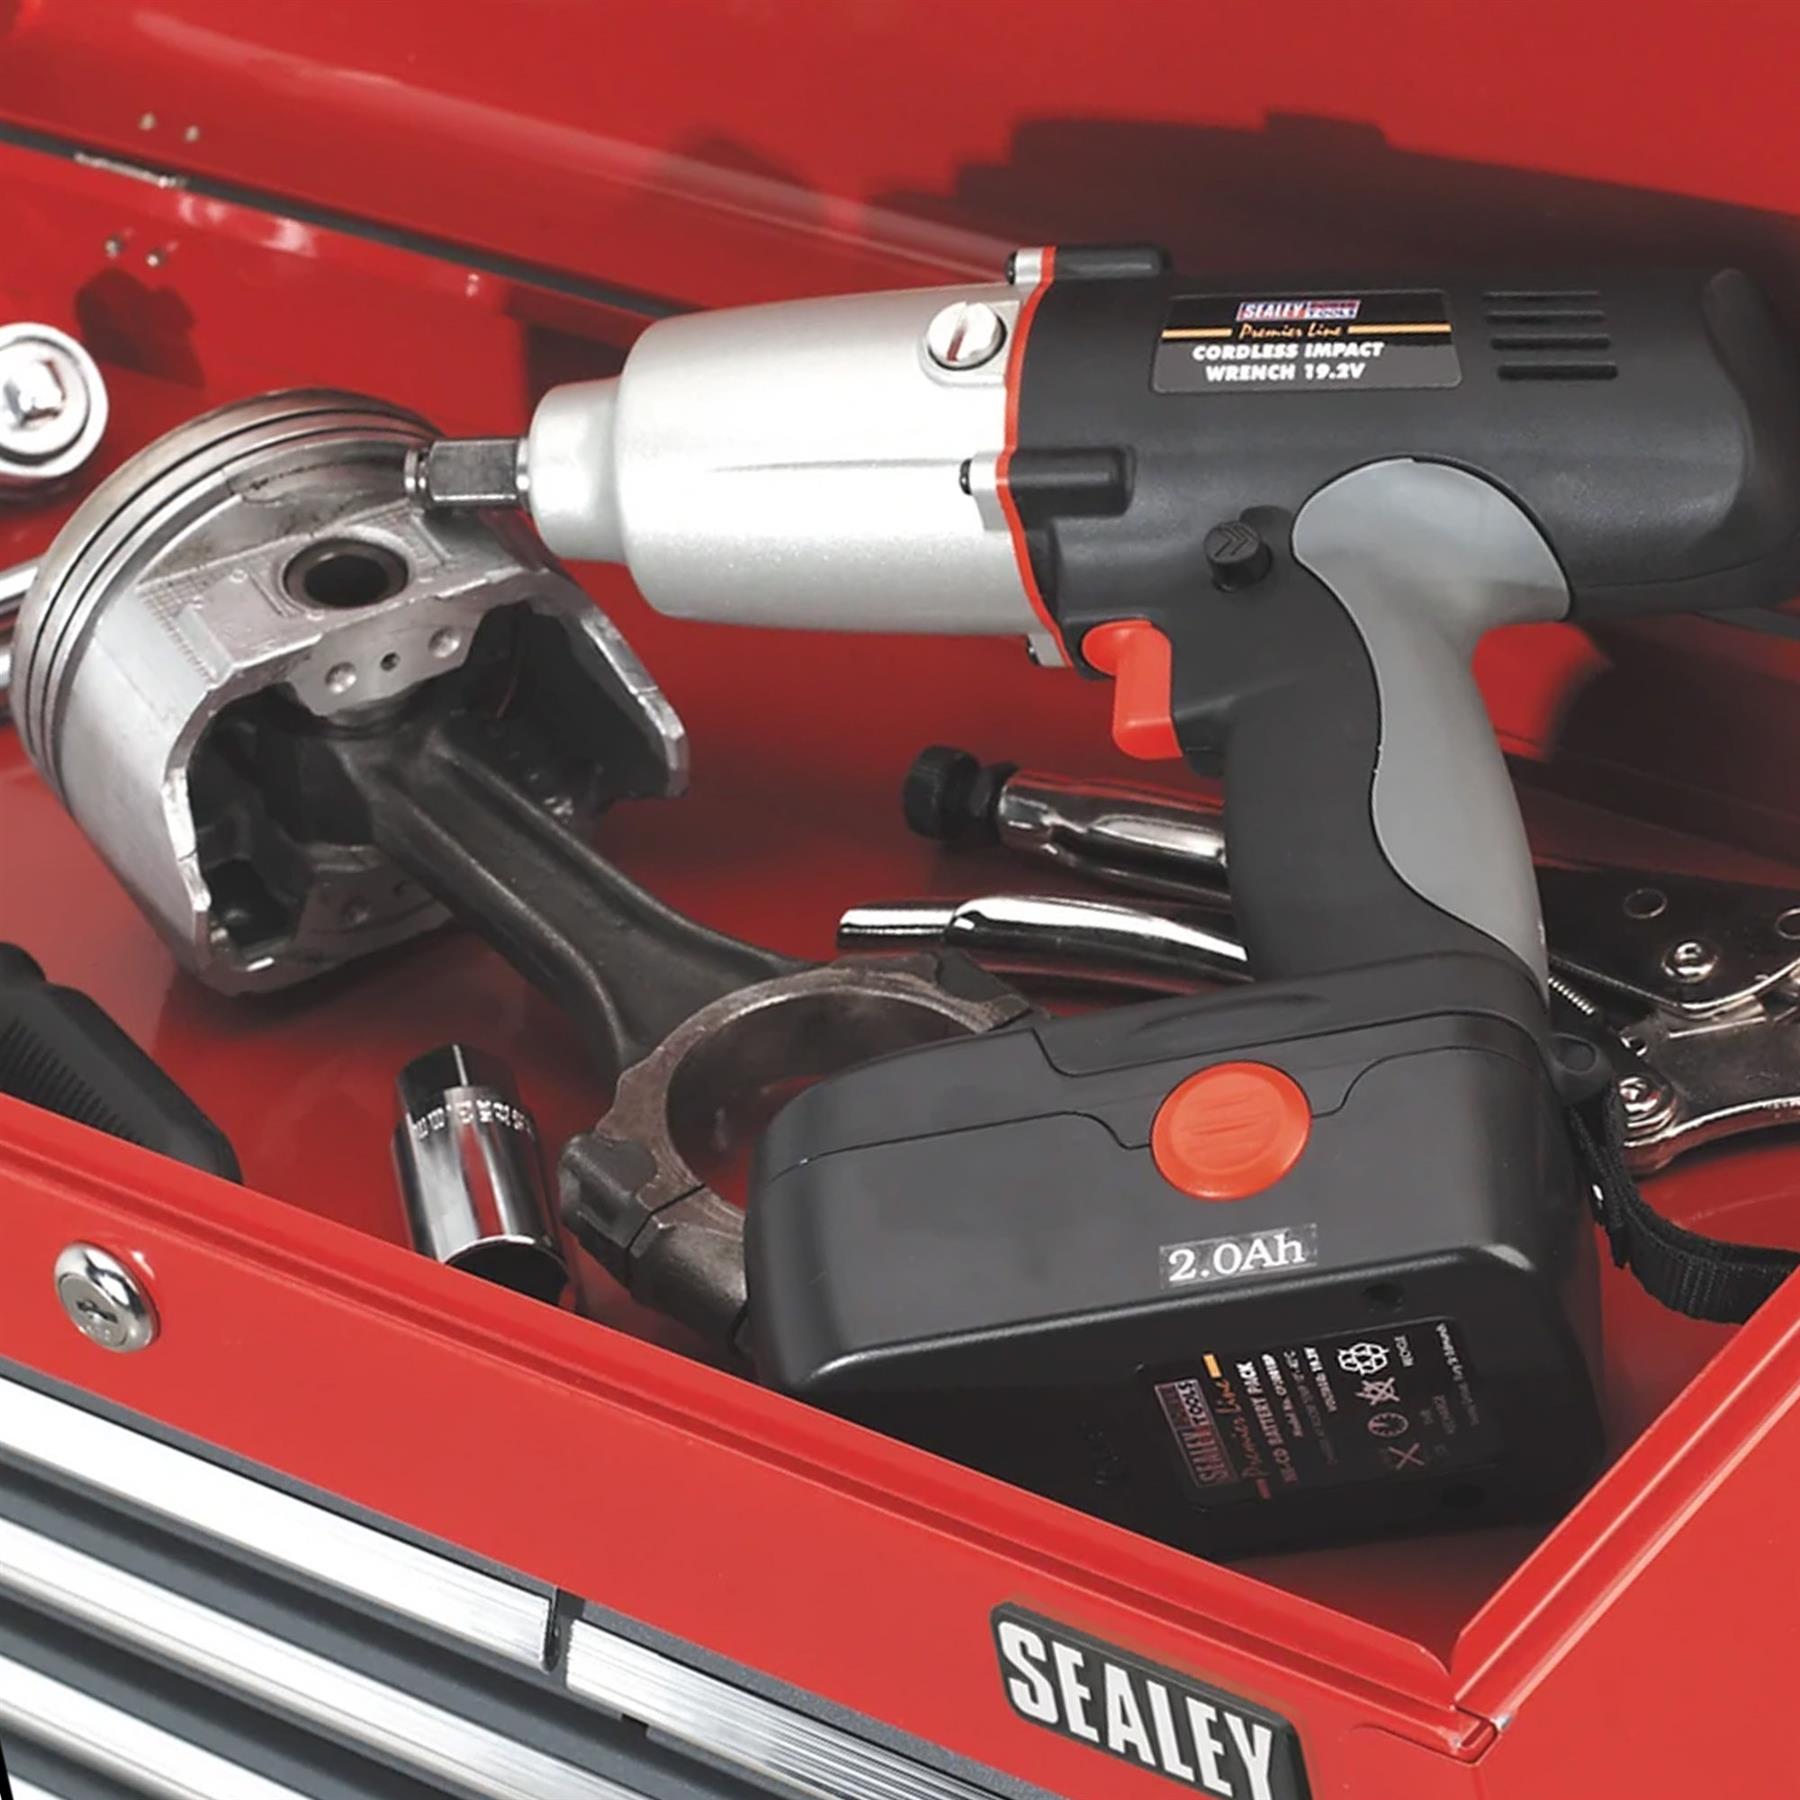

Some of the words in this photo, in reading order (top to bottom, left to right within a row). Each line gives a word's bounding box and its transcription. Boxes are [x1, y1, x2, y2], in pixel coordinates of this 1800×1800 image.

[1244, 302, 1303, 319] SEALEY
[1239, 322, 1302, 340] Premier
[1307, 322, 1342, 337] Line
[1192, 343, 1298, 360] CORDLESS
[1304, 342, 1384, 358] IMPACT
[1206, 364, 1295, 382] WRENCH
[1304, 363, 1366, 379] 19.2V
[1169, 1233, 1306, 1281] 2.0Ah
[1214, 1378, 1242, 1414] Line
[1236, 1361, 1261, 1395] PACK
[1177, 1382, 1207, 1424] TOOLS
[1251, 1397, 1283, 1445] BATTERY
[1180, 1427, 1231, 1482] SEALEY
[998, 1621, 1273, 1800] SEALEY
